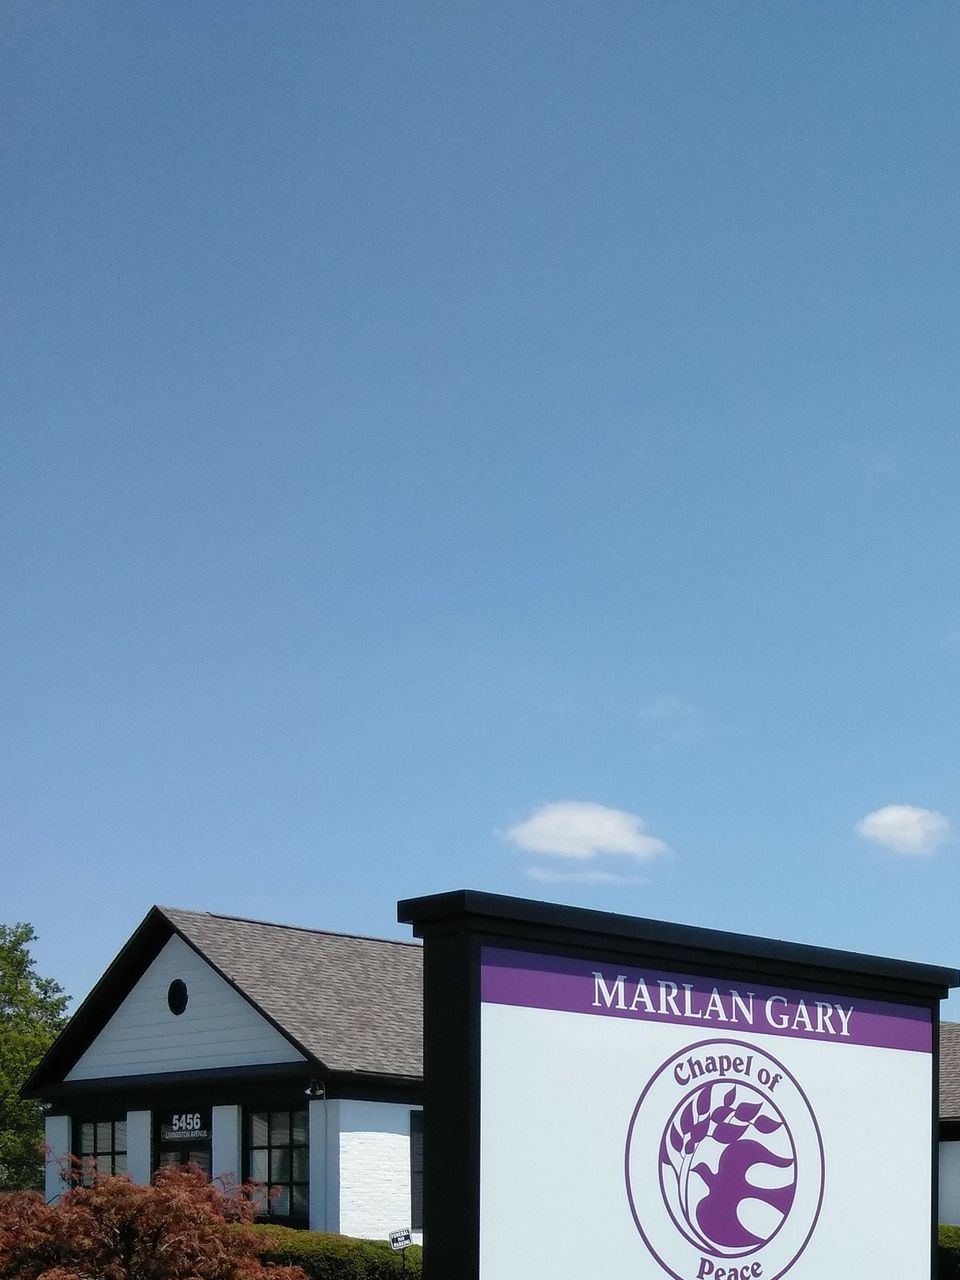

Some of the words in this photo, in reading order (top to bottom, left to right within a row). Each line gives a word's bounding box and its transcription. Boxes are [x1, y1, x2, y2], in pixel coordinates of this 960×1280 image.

[592, 971, 755, 1025] MARLAN
[764, 995, 854, 1037] GARY
[673, 1054, 754, 1086] Chapel
[757, 1068, 783, 1092] of
[172, 1113, 201, 1131] 5456
